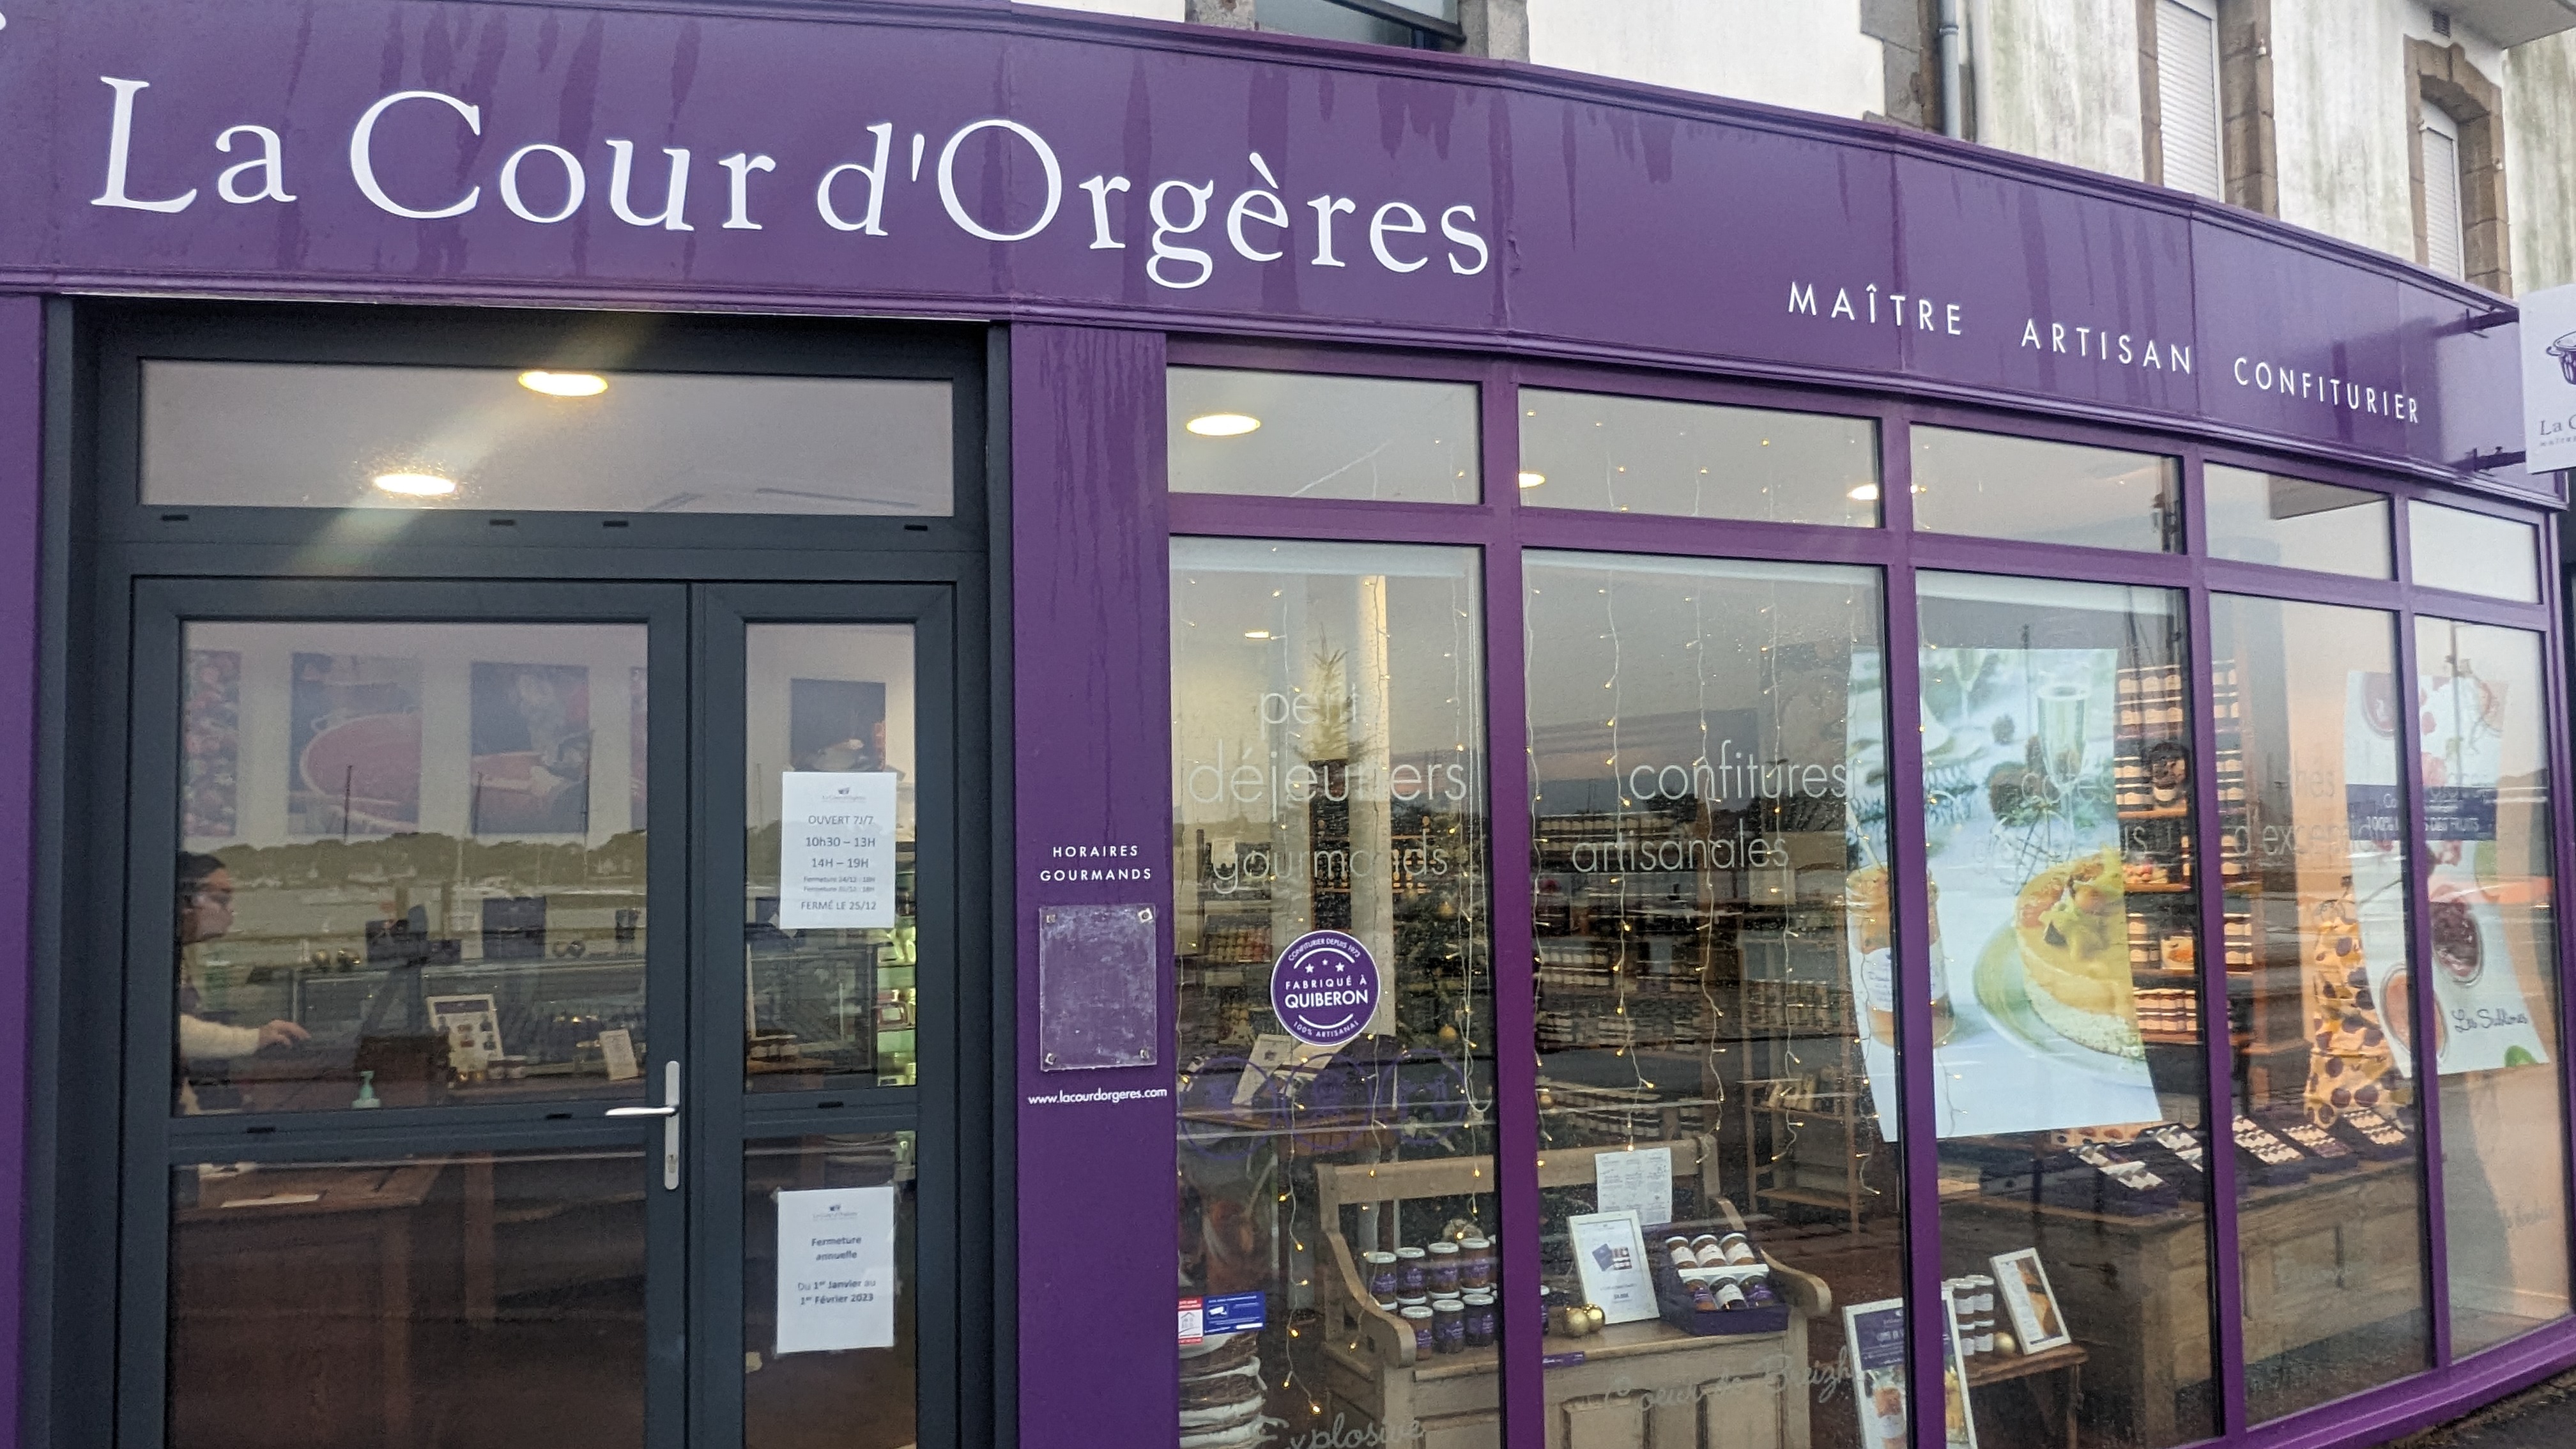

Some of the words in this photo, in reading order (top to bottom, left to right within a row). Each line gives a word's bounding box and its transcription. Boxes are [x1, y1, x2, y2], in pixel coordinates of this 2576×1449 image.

[91, 75, 297, 213] La
[349, 90, 776, 232] Cour
[816, 118, 1489, 289] d'Orgères
[1788, 282, 1963, 335] MAÎTRE
[2021, 318, 2191, 376] ARTISAN
[2234, 356, 2419, 424] CONFITURIER
[2540, 419, 2563, 436] La
[1629, 739, 1846, 801] confitures
[808, 815, 850, 825] OUVERT
[806, 837, 841, 847] 10h30
[854, 837, 875, 847] 13H
[1572, 818, 1788, 873] artisanales
[1053, 845, 1138, 857] HORAIRES
[812, 858, 833, 868] 14H
[847, 858, 869, 868] 19H
[1212, 828, 1448, 894] gourmads
[1040, 868, 1151, 882] GOURMANDS
[801, 900, 832, 910] FERMÉ
[836, 901, 846, 910] LE
[849, 901, 876, 910] 25/12
[1288, 938, 1325, 961] CONFITURIER
[1326, 938, 1347, 949] DEPUIS
[1285, 975, 1352, 990] FABRIQUÉ
[1360, 974, 1367, 986] À
[1285, 989, 1368, 1009] QUIBERON
[1293, 1021, 1312, 1036] 100%
[1028, 1087, 1167, 1105] www.lacourdorgeres.com
[811, 1237, 862, 1246] Fermeture
[816, 1250, 857, 1261] annuelle
[798, 1282, 811, 1291] Du
[815, 1295, 848, 1304] Février
[850, 1292, 874, 1303] 2023
